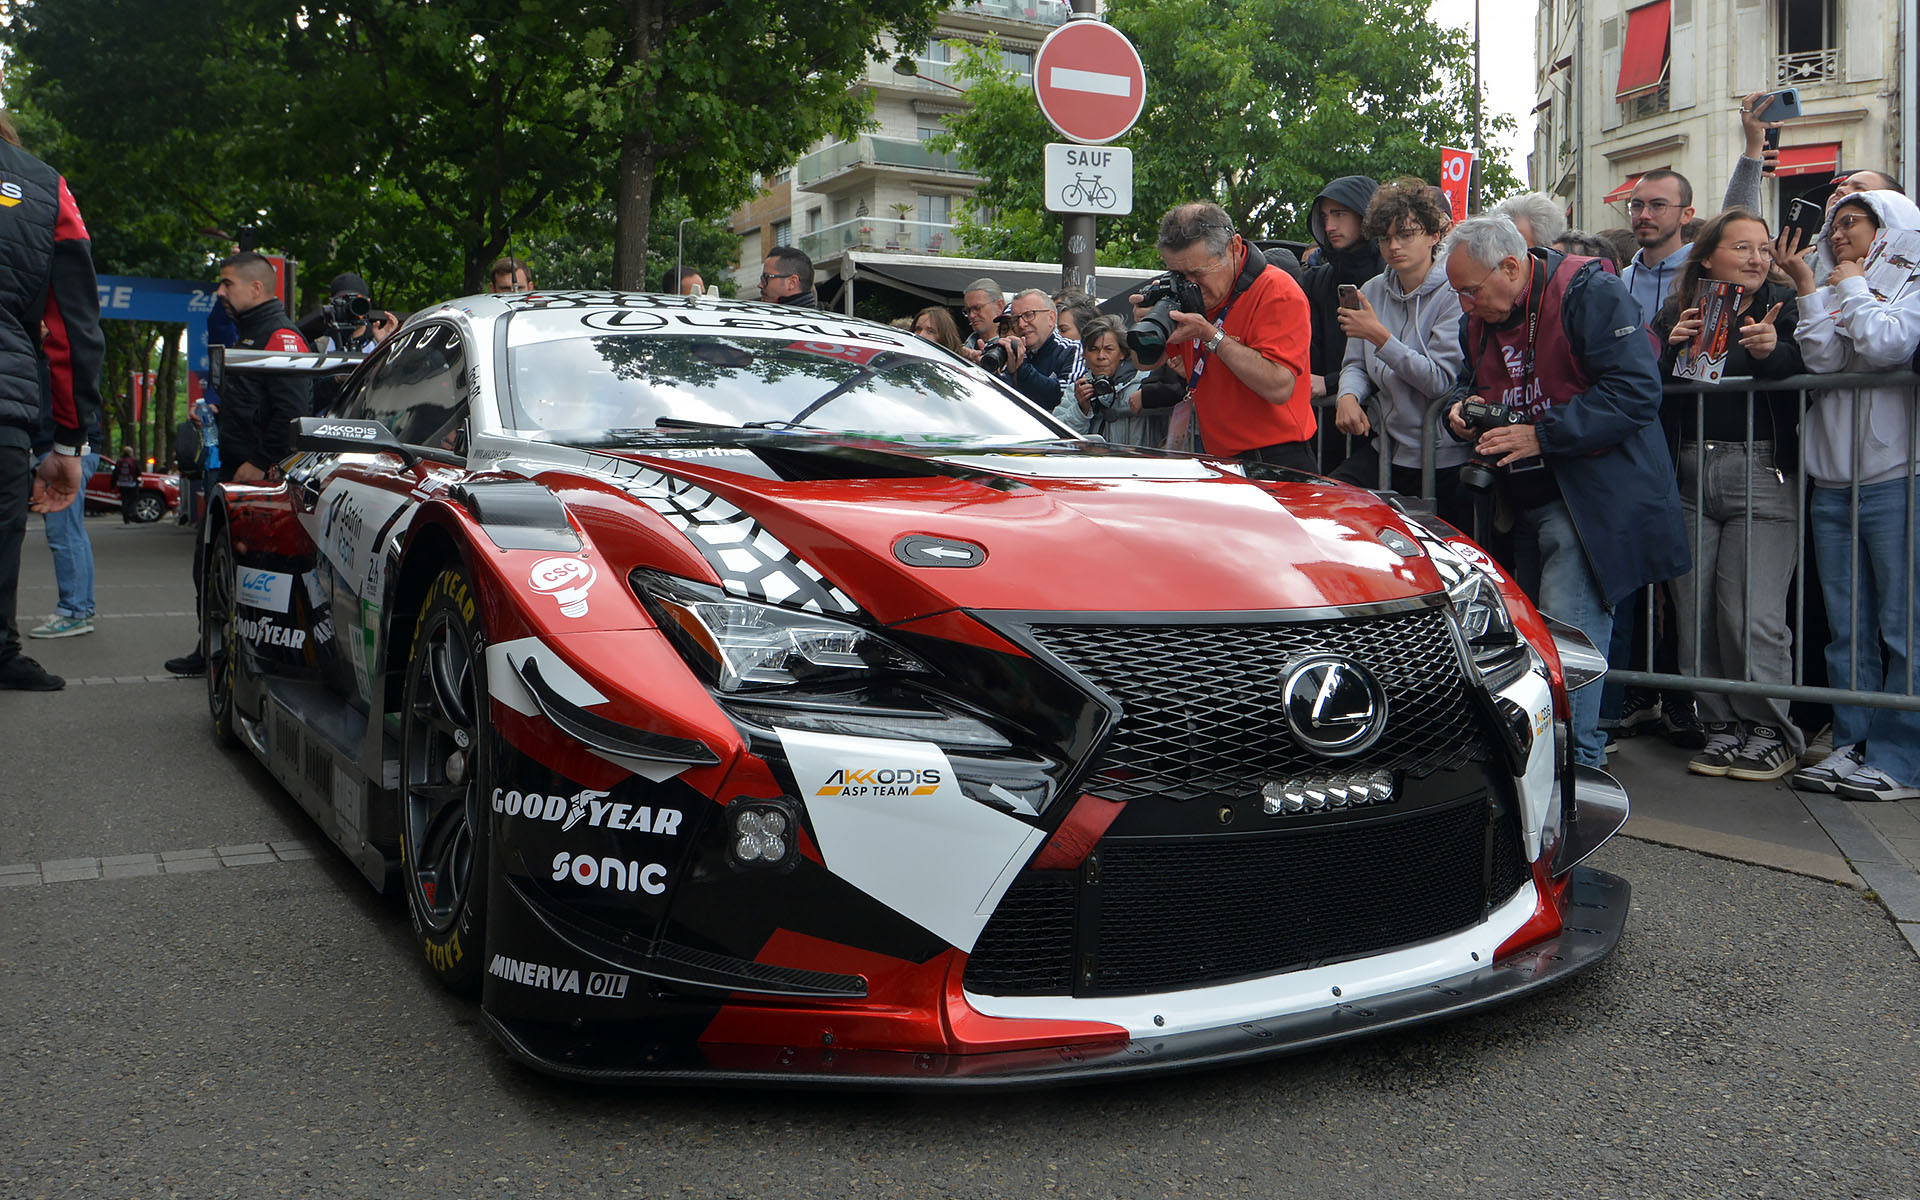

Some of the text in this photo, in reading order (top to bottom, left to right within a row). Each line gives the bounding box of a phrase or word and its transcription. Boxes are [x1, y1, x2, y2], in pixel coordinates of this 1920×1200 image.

[1067, 150, 1111, 167] SAUF
[676, 315, 904, 347] LEXUS
[543, 563, 579, 582] CSC
[841, 786, 909, 797] ASP TEAM
[491, 787, 683, 836] GOODYEAR
[488, 954, 625, 996] MINERVA OIL
